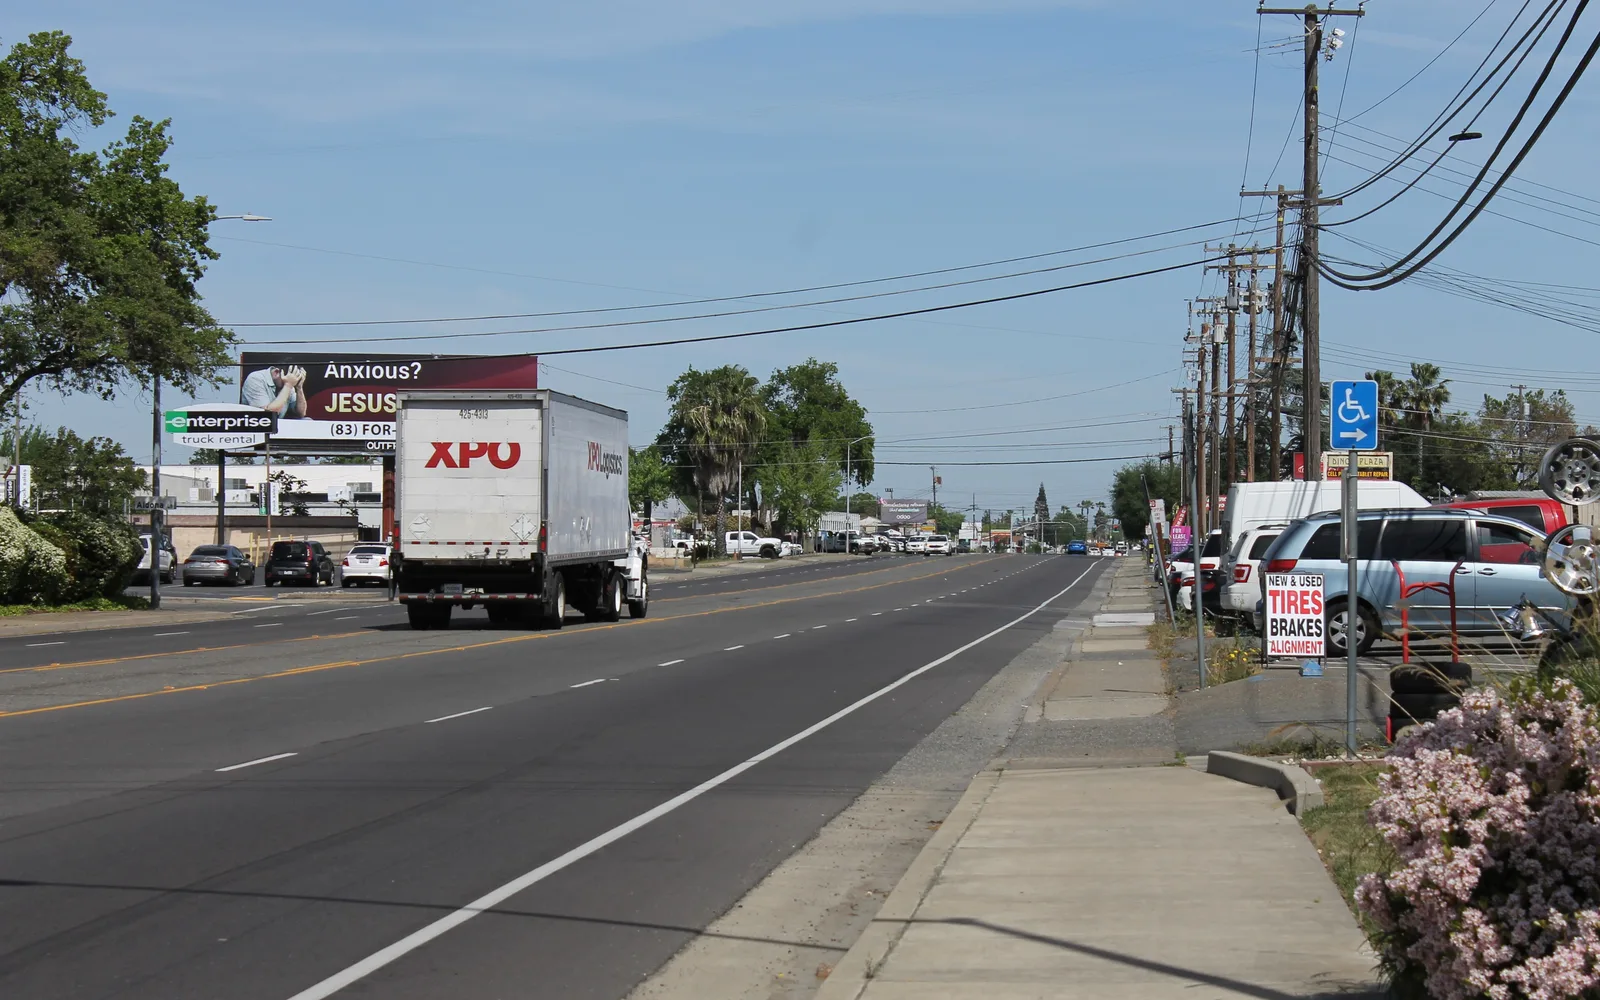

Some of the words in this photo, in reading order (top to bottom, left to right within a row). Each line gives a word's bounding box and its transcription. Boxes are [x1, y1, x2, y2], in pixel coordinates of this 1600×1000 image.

[324, 360, 422, 379] Anxious?
[324, 393, 397, 413] JESUS
[170, 414, 272, 430] enterprise
[330, 423, 358, 436] (83)
[182, 434, 214, 444] truck
[219, 434, 256, 444] rental
[424, 442, 521, 469] XPO
[1360, 457, 1384, 465] PLAZA
[1268, 575, 1288, 587] NEW
[1290, 576, 1297, 587] &
[1299, 576, 1323, 587] USED
[1268, 590, 1323, 615] TIRES
[1270, 618, 1323, 637] BRAKES
[1270, 640, 1323, 654] ALIGNMENT
